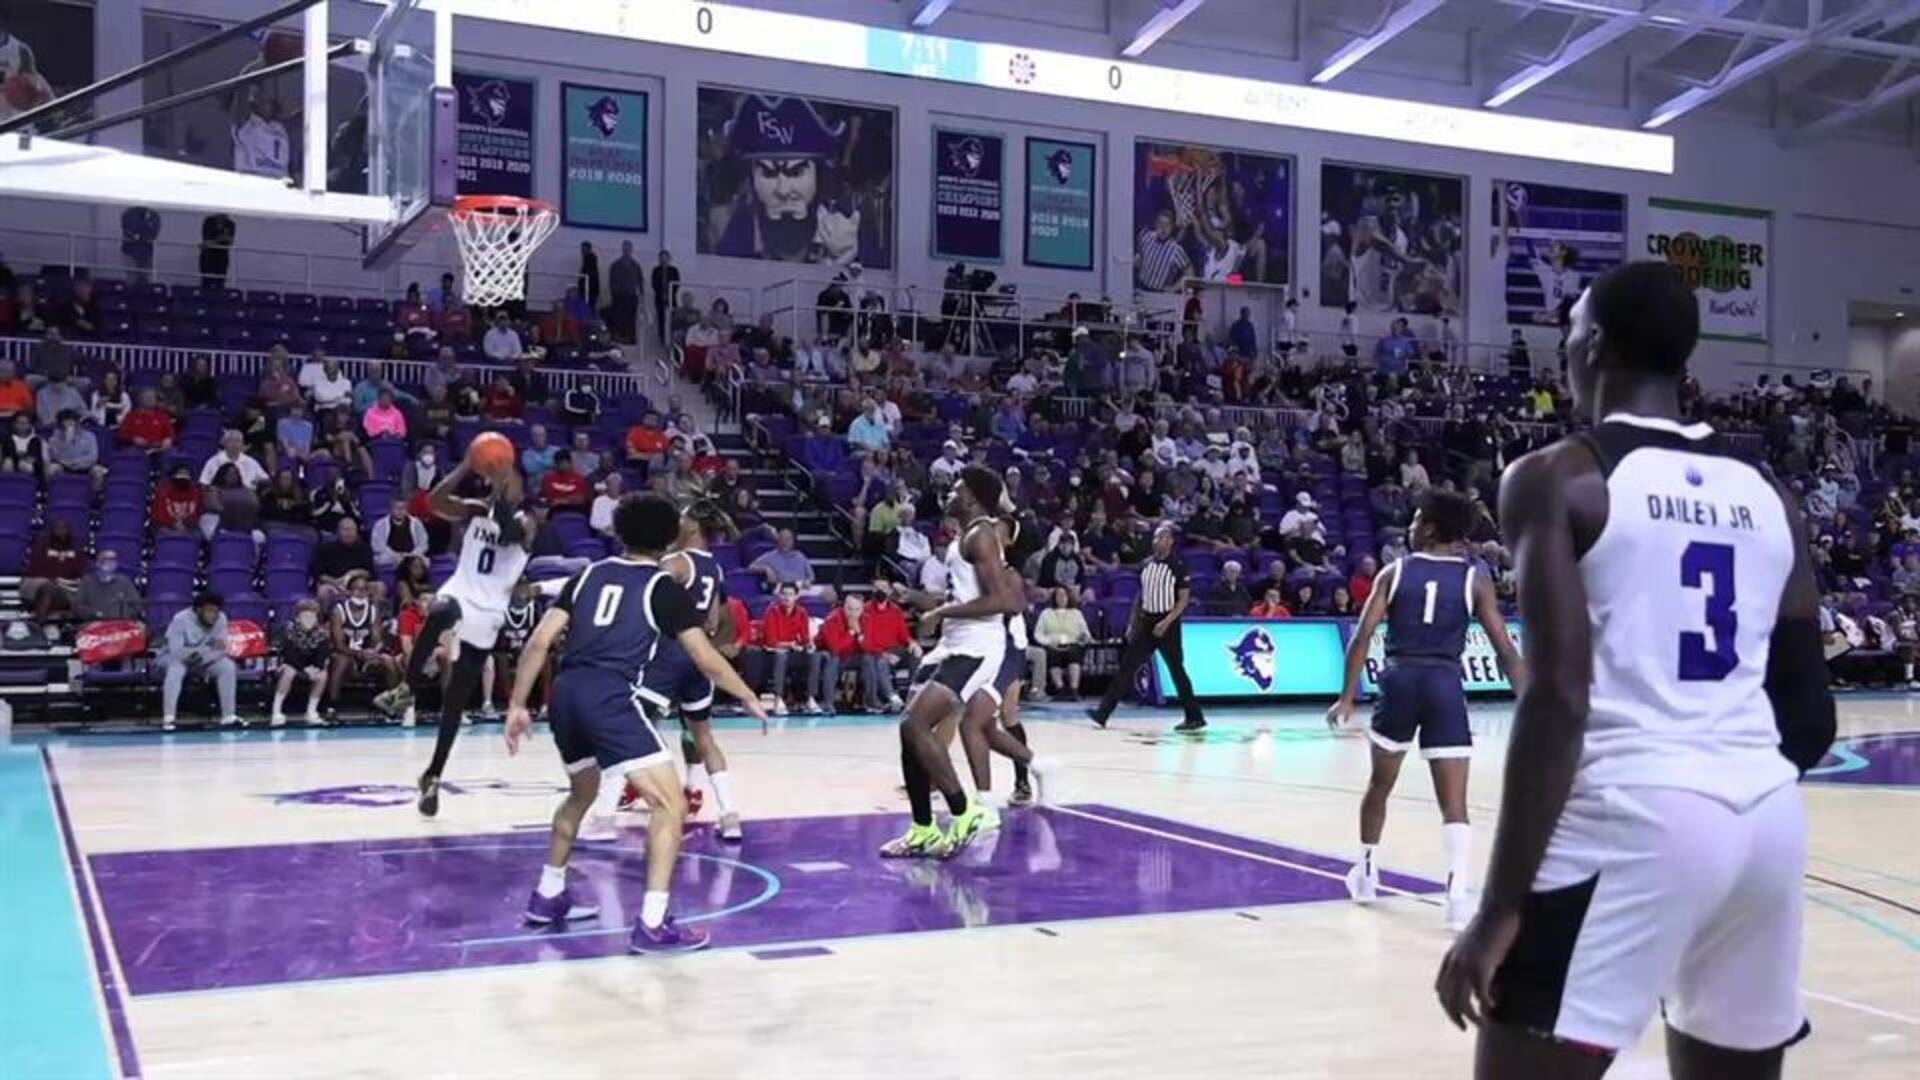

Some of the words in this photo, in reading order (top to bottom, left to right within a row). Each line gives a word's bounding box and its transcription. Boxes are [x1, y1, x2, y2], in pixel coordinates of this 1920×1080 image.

[697, 6, 713, 35] 0
[1107, 64, 1123, 91] 0
[758, 111, 794, 145] FSW
[1647, 233, 1763, 267] CROWTHER
[1675, 264, 1752, 291] OFING
[1648, 495, 1718, 526] DAILEY
[478, 547, 496, 574] 0
[593, 584, 624, 626] 0
[695, 576, 714, 610] 3
[1423, 580, 1438, 624] 1
[1678, 541, 1740, 682] 3
